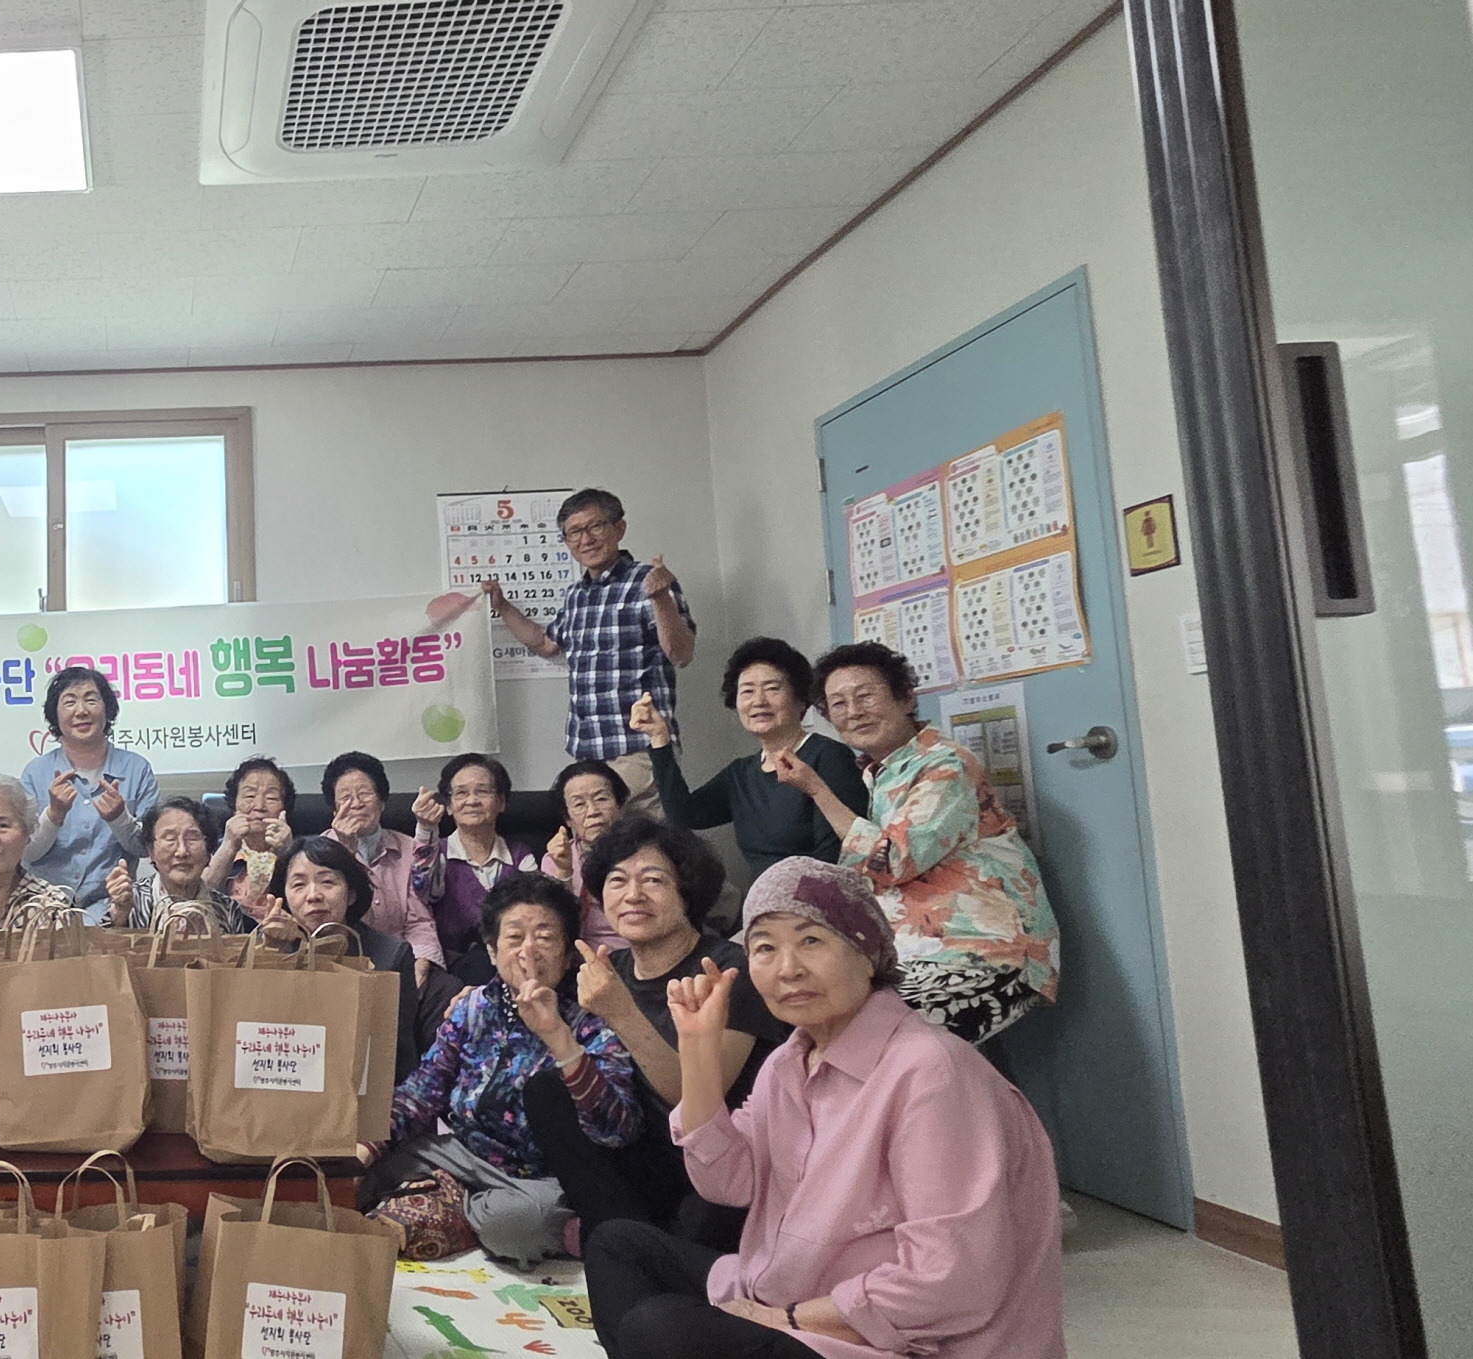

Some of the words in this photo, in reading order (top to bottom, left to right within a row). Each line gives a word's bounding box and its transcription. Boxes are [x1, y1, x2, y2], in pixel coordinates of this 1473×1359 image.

[497, 500, 514, 519] 5
[523, 536, 528, 544] 1
[540, 535, 547, 544] 2
[454, 556, 461, 565] 4
[471, 555, 479, 565] 5
[488, 554, 496, 565] 6
[506, 554, 513, 563] 7
[524, 553, 531, 562] 8
[541, 552, 548, 562] 9
[556, 552, 568, 561] 10
[454, 574, 464, 584] 11
[470, 573, 482, 583] 12
[487, 573, 499, 581] 13
[505, 572, 517, 581] 14
[522, 571, 535, 581] 15
[540, 570, 553, 580] 16
[558, 569, 570, 579] 17
[507, 590, 518, 600] 21
[524, 589, 537, 599] 22
[541, 589, 555, 598] 23
[525, 607, 538, 617] 29
[543, 607, 556, 616] 30
[209, 635, 295, 698] 행복
[307, 632, 462, 690] 나눔활동”
[106, 723, 256, 750] 주시자원봉사센터
